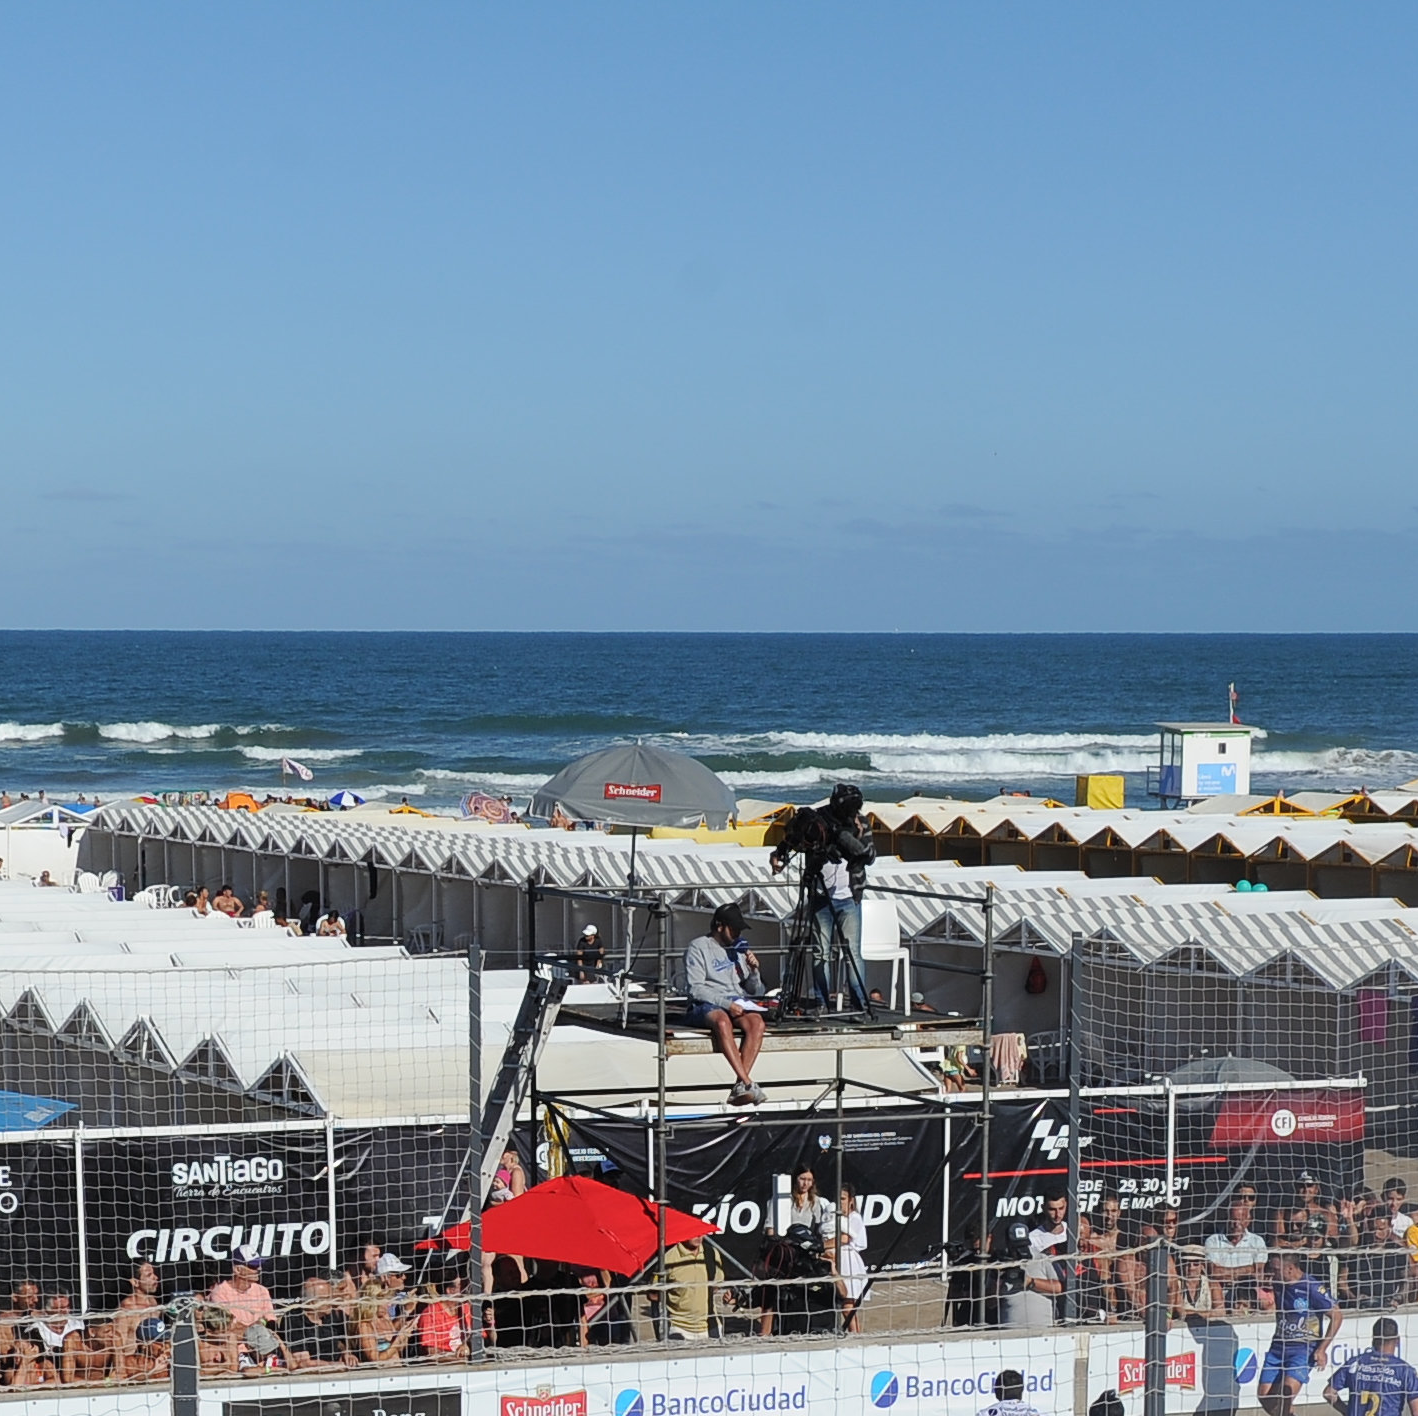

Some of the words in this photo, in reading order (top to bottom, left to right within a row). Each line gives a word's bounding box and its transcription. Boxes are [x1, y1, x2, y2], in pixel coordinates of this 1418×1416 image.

[608, 785, 657, 797] Schneider
[1274, 1117, 1292, 1129] CFI
[1141, 1178, 1159, 1192] 30
[1172, 1176, 1190, 1191] 31
[126, 1220, 331, 1266] CIRCUITO
[1123, 1359, 1191, 1383] Schder
[906, 1369, 1053, 1398] BancoCiad
[651, 1385, 806, 1416] BancoCiudad
